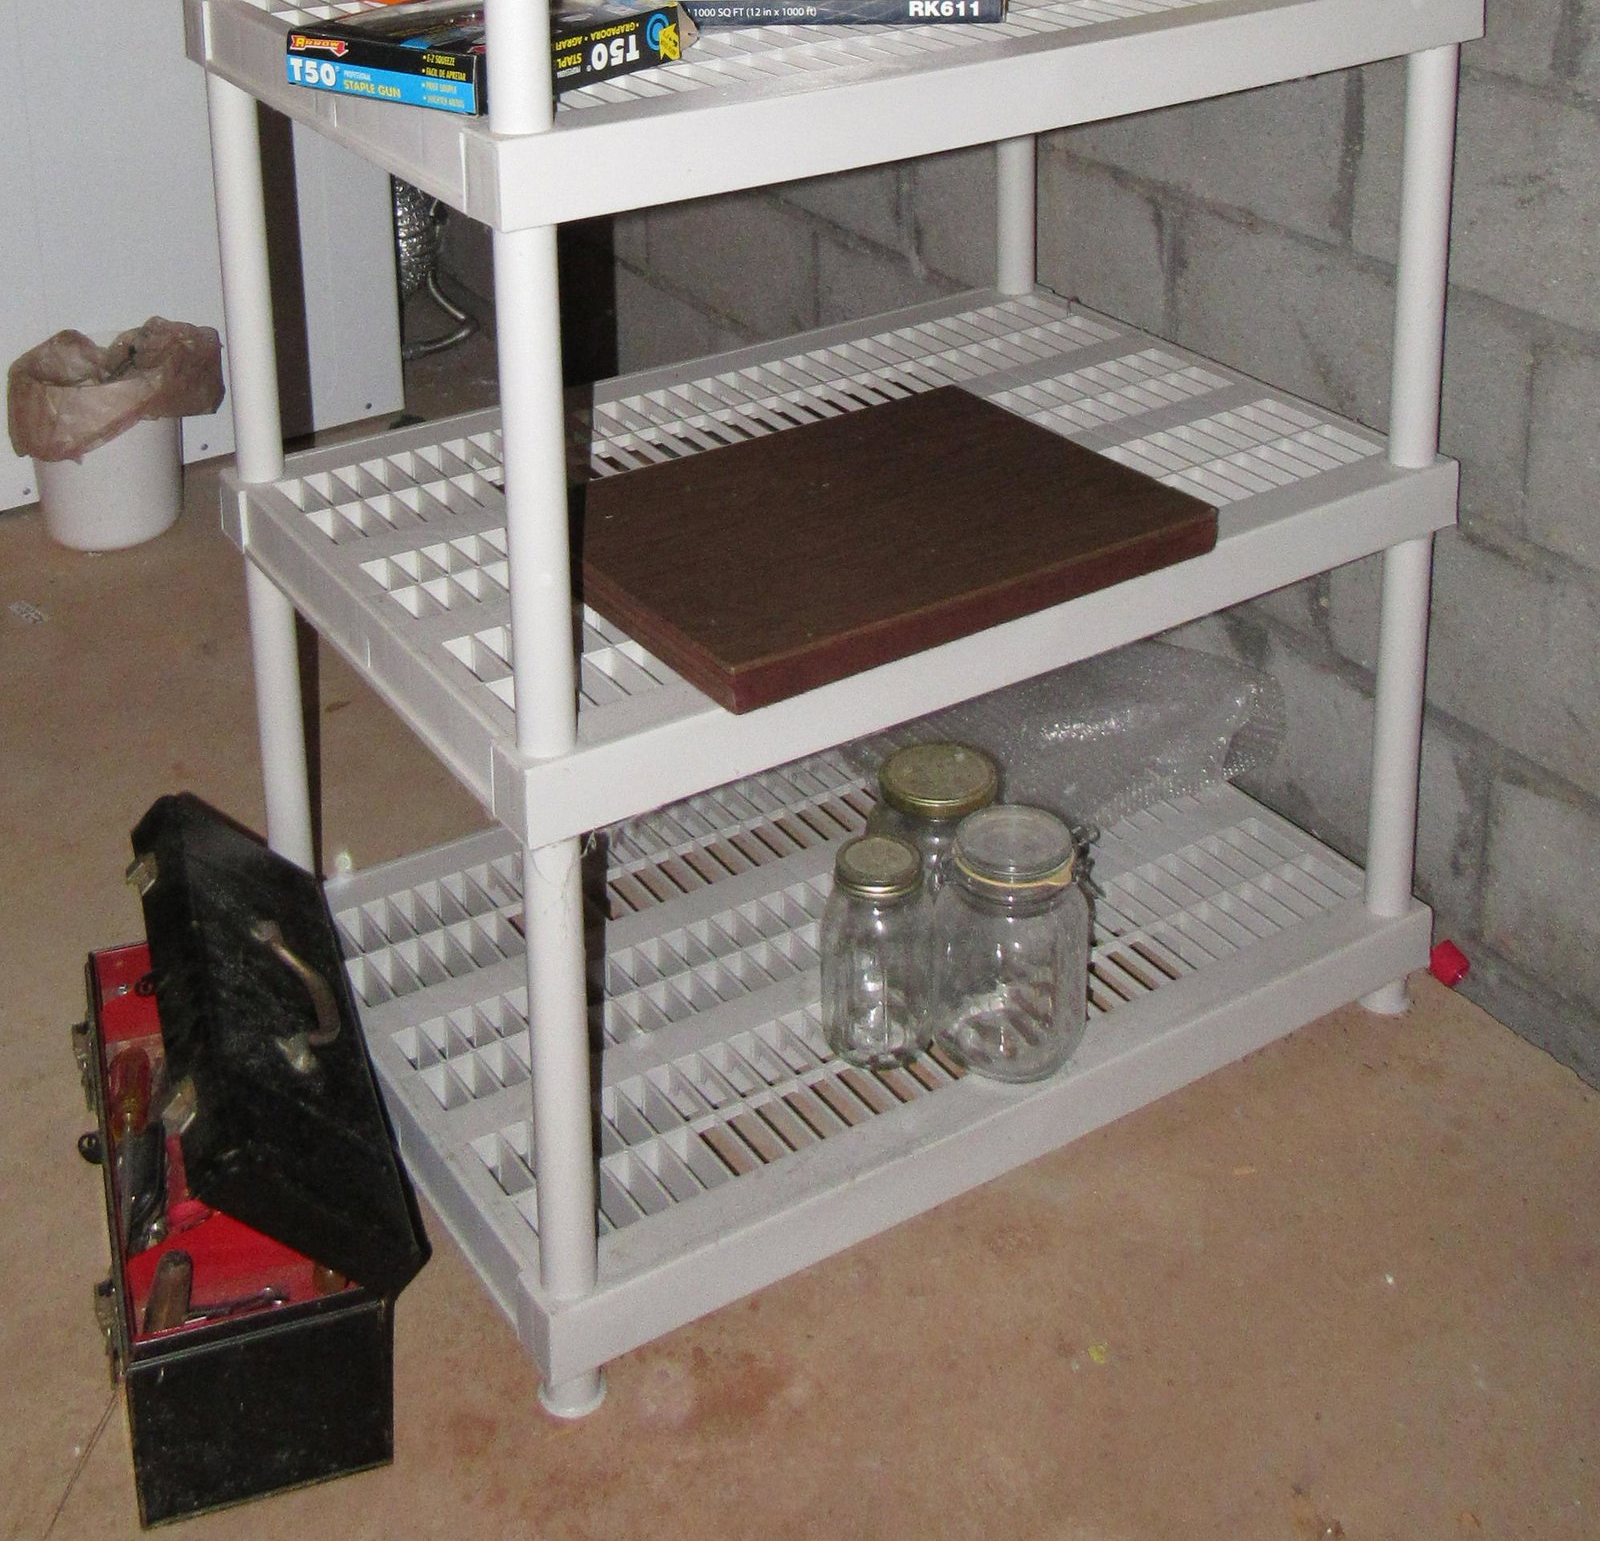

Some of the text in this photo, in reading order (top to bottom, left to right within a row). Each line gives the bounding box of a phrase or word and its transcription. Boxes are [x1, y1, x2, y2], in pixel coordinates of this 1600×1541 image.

[693, 6, 817, 19] 1000 SQ FT (12 in x 1000 ft)
[908, 0, 980, 18] RK611
[590, 22, 636, 41] GRAPADORA
[557, 53, 583, 68] STAPL
[591, 34, 640, 71] T50
[289, 58, 337, 87] T50
[344, 80, 401, 98] STAPLE GUN
